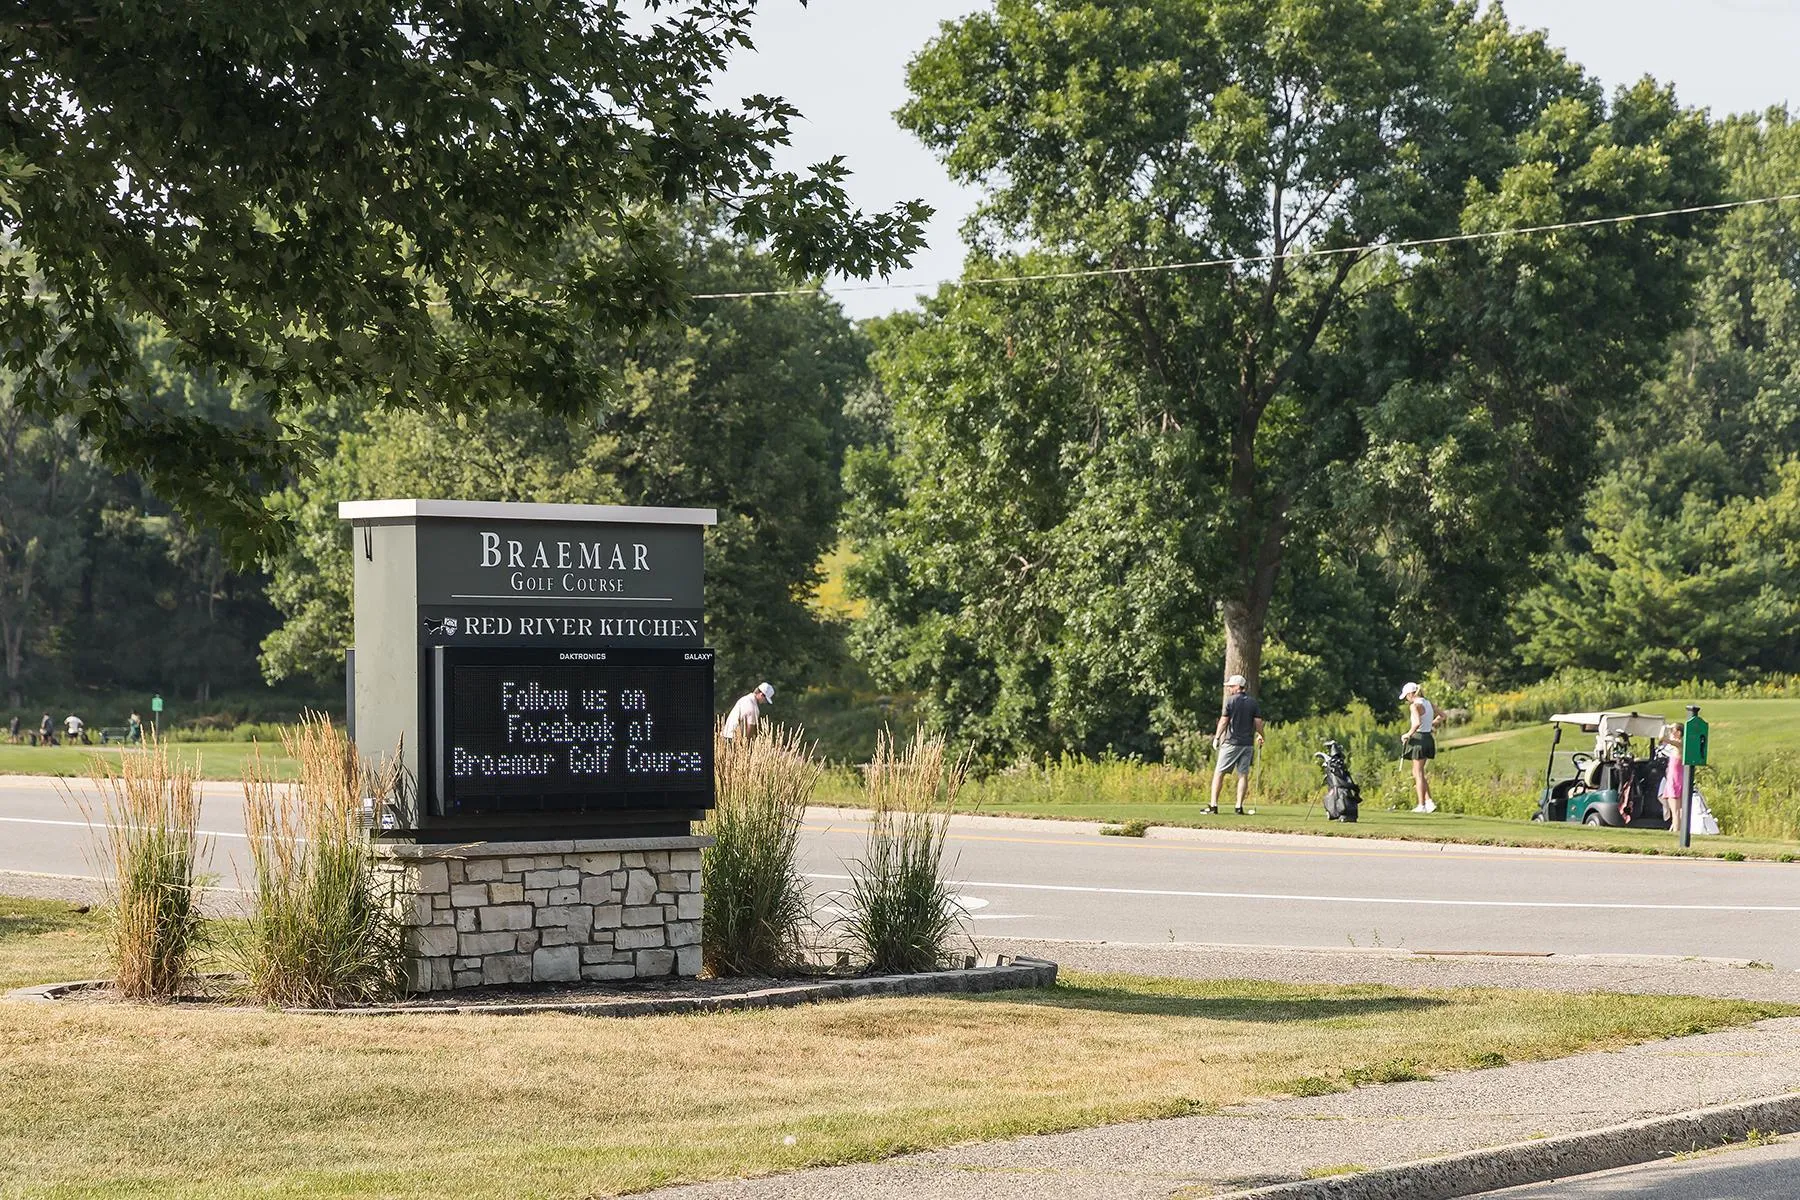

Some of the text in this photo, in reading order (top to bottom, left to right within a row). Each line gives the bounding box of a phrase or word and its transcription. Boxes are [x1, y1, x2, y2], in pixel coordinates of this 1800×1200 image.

[480, 532, 650, 570] BRAEMAR
[511, 572, 624, 591] GOLF COURSE
[465, 617, 698, 636] RED RIVER KITCHEN
[560, 653, 606, 661] DAKTRONICS
[503, 682, 645, 710] Follow us on
[509, 714, 653, 742] Facebook at
[455, 745, 701, 775] Braemar Golf Course
